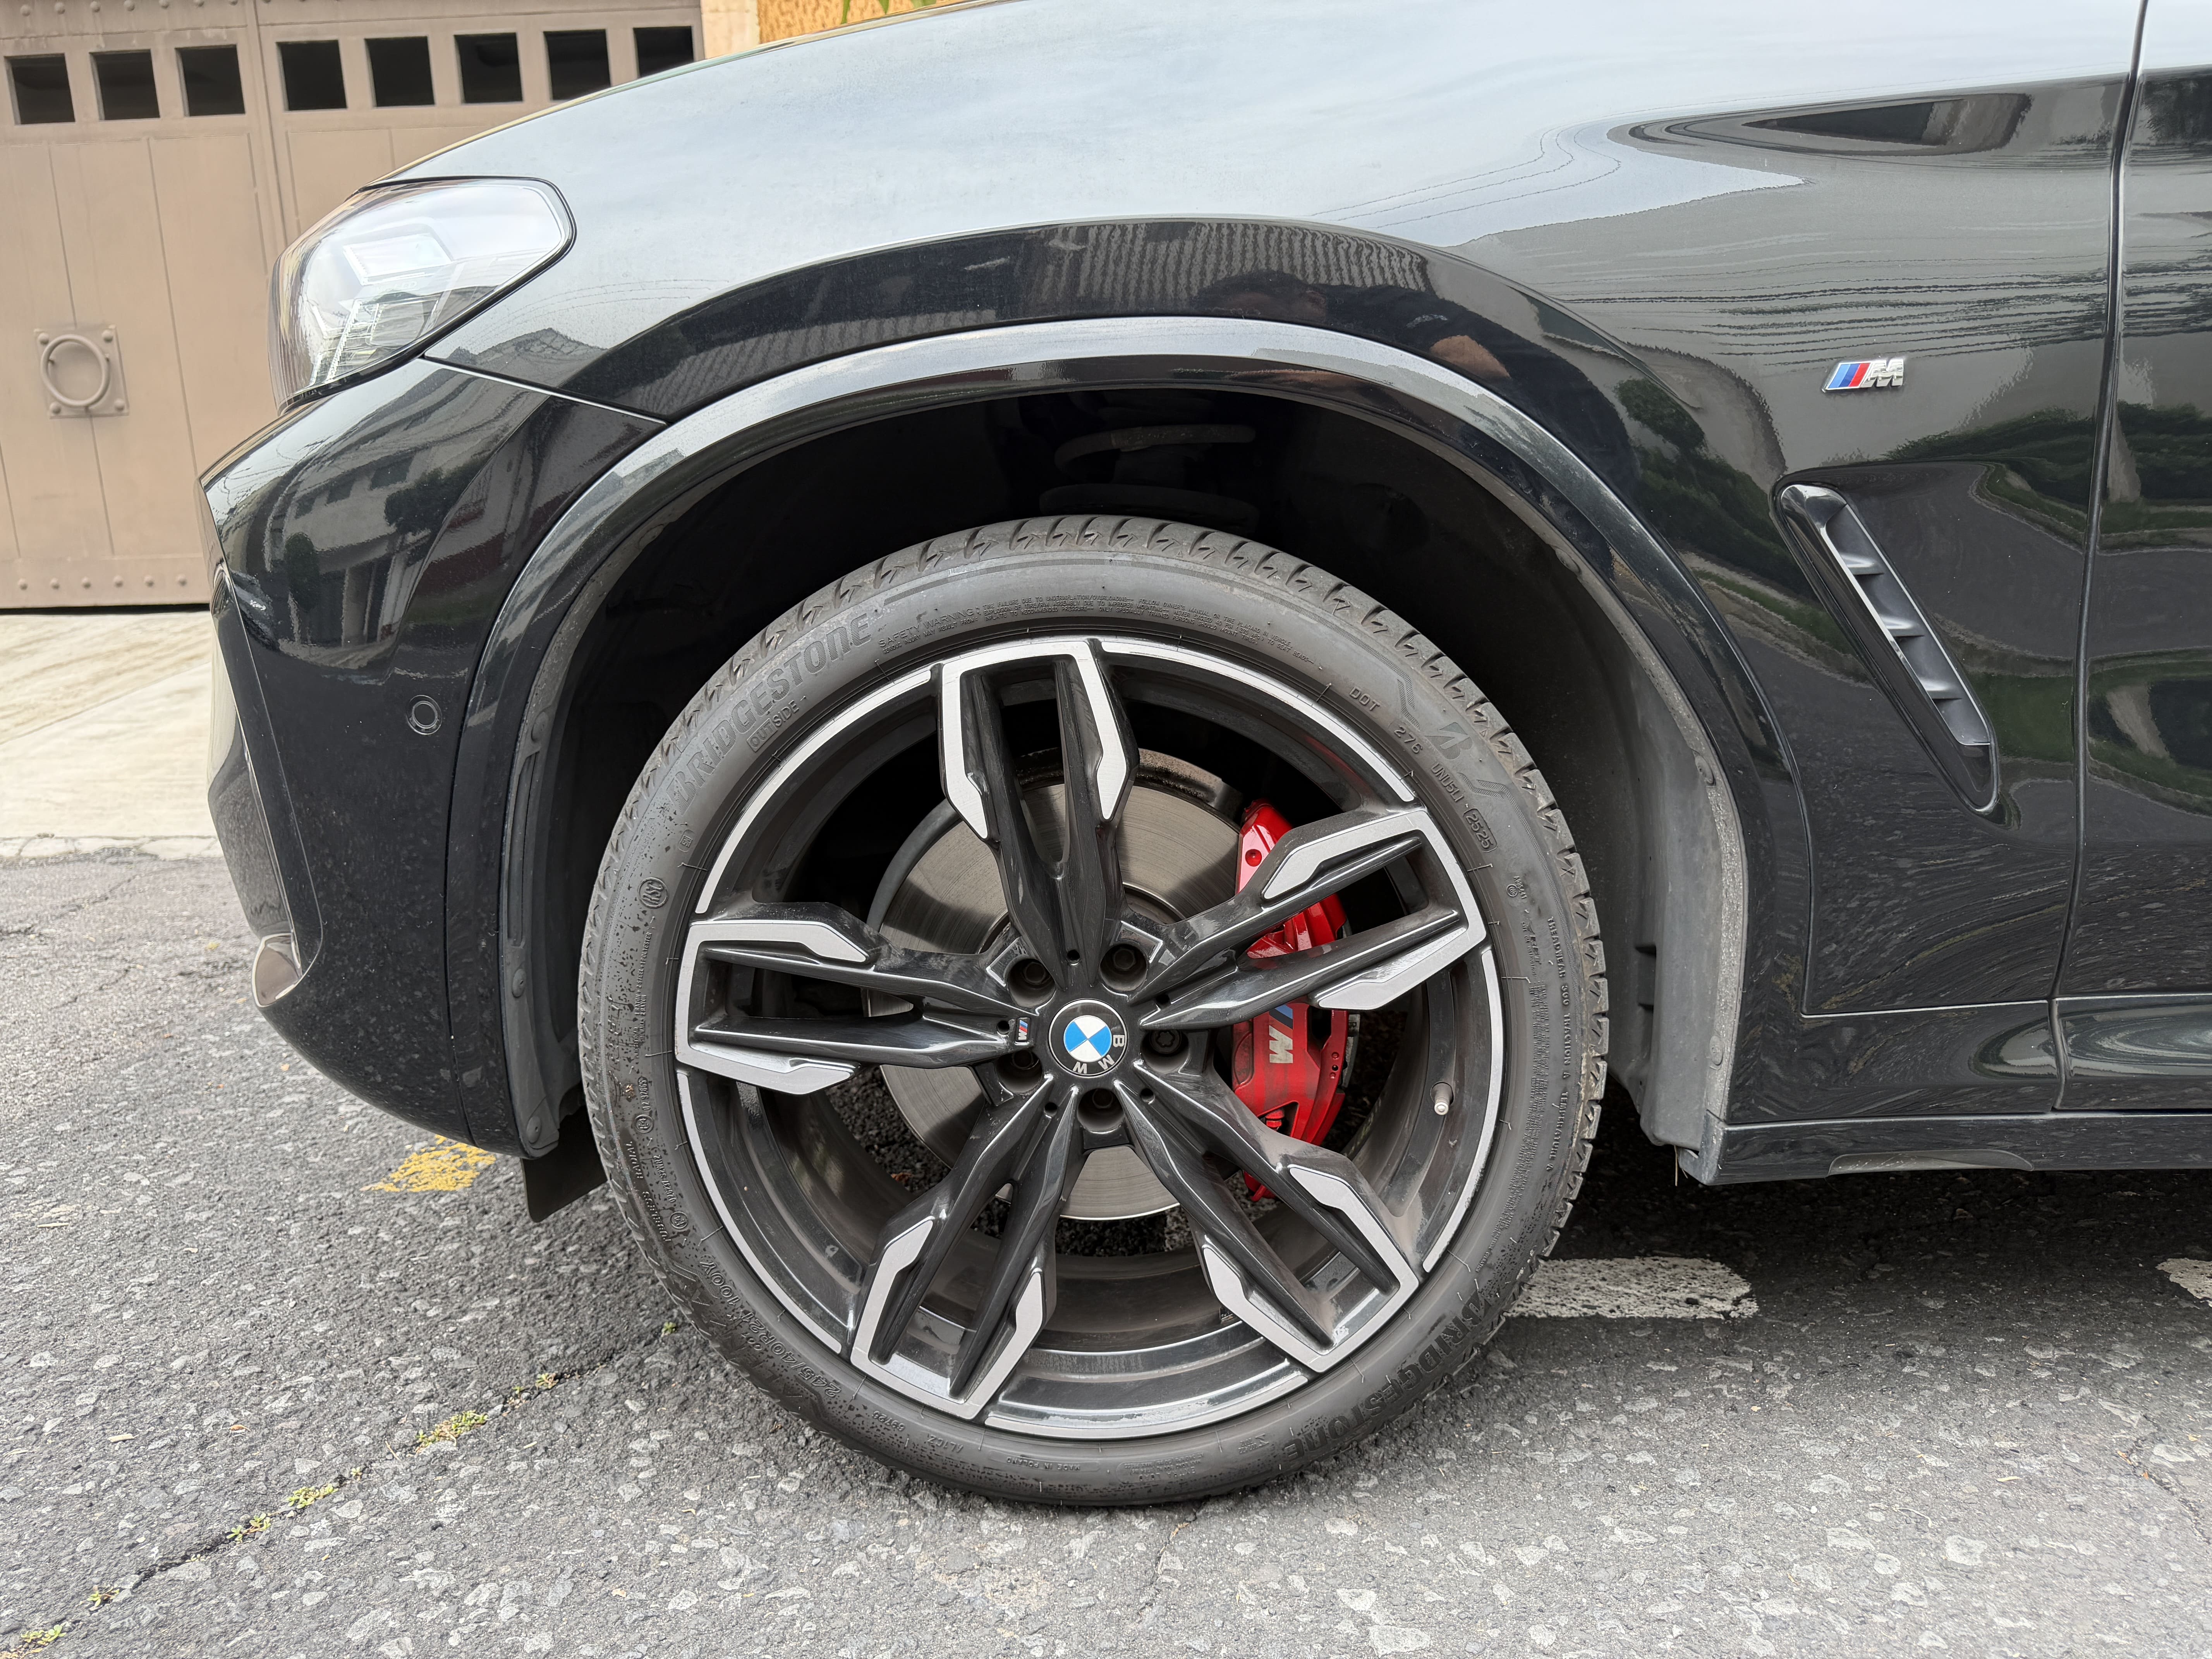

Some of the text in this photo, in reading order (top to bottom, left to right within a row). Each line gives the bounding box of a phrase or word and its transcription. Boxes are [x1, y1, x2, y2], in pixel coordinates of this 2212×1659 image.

[879, 623, 921, 648] SAFETY
[882, 641, 902, 655] SERIOUS
[904, 633, 921, 645] INJURY
[922, 628, 936, 638] MAY
[938, 620, 958, 632] RESULT
[982, 602, 995, 611] TIRE
[998, 598, 1019, 608] FAILURE
[1163, 601, 1186, 610] OWNER'S
[1188, 606, 1209, 616] MANUAL
[1223, 615, 1236, 624] TIRE
[1237, 620, 1262, 634] PLACARD
[983, 605, 1012, 616] EXPLOSION
[1174, 609, 1191, 618] NEVER
[1192, 613, 1213, 623] EXCEED
[1224, 622, 1235, 630] PSI
[1266, 638, 1276, 646] TO
[1276, 642, 1291, 654] SEAT
[984, 611, 1008, 622] INFLATE
[1021, 606, 1059, 616] RECOMMENDED
[1115, 606, 1144, 615] SPECIALLY
[1147, 610, 1170, 619] TRAINED
[1172, 614, 1195, 624] PERSONS
[1197, 620, 1218, 630] SHOULD
[1219, 625, 1239, 637] MOUNT
[749, 700, 799, 748] OUTSIDE
[666, 612, 872, 892] BRIDGESTONE
[1349, 686, 1381, 712] DOT
[1393, 725, 1423, 754] 276
[1465, 812, 1493, 849] 2525
[641, 877, 665, 907] RSC
[636, 967, 644, 986] STEEL
[640, 931, 653, 963] POLYESTER
[1546, 914, 1567, 979] TREADWEAR
[1073, 1035, 1125, 1074] BMW
[1269, 1025, 1293, 1063] M
[1563, 1011, 1571, 1066] TRACTION
[1562, 1070, 1571, 1079] A
[1547, 1090, 1570, 1160] TEMPERATURE
[625, 1140, 672, 1242] TUBELESS RADIAL
[690, 1290, 802, 1398] ALENZA
[700, 1260, 841, 1397] 245/40R21 100Y
[740, 1332, 763, 1352] 001
[1282, 1289, 1491, 1461] BRIDGESTONE
[1005, 1456, 1081, 1472] MADE IN POLAND
